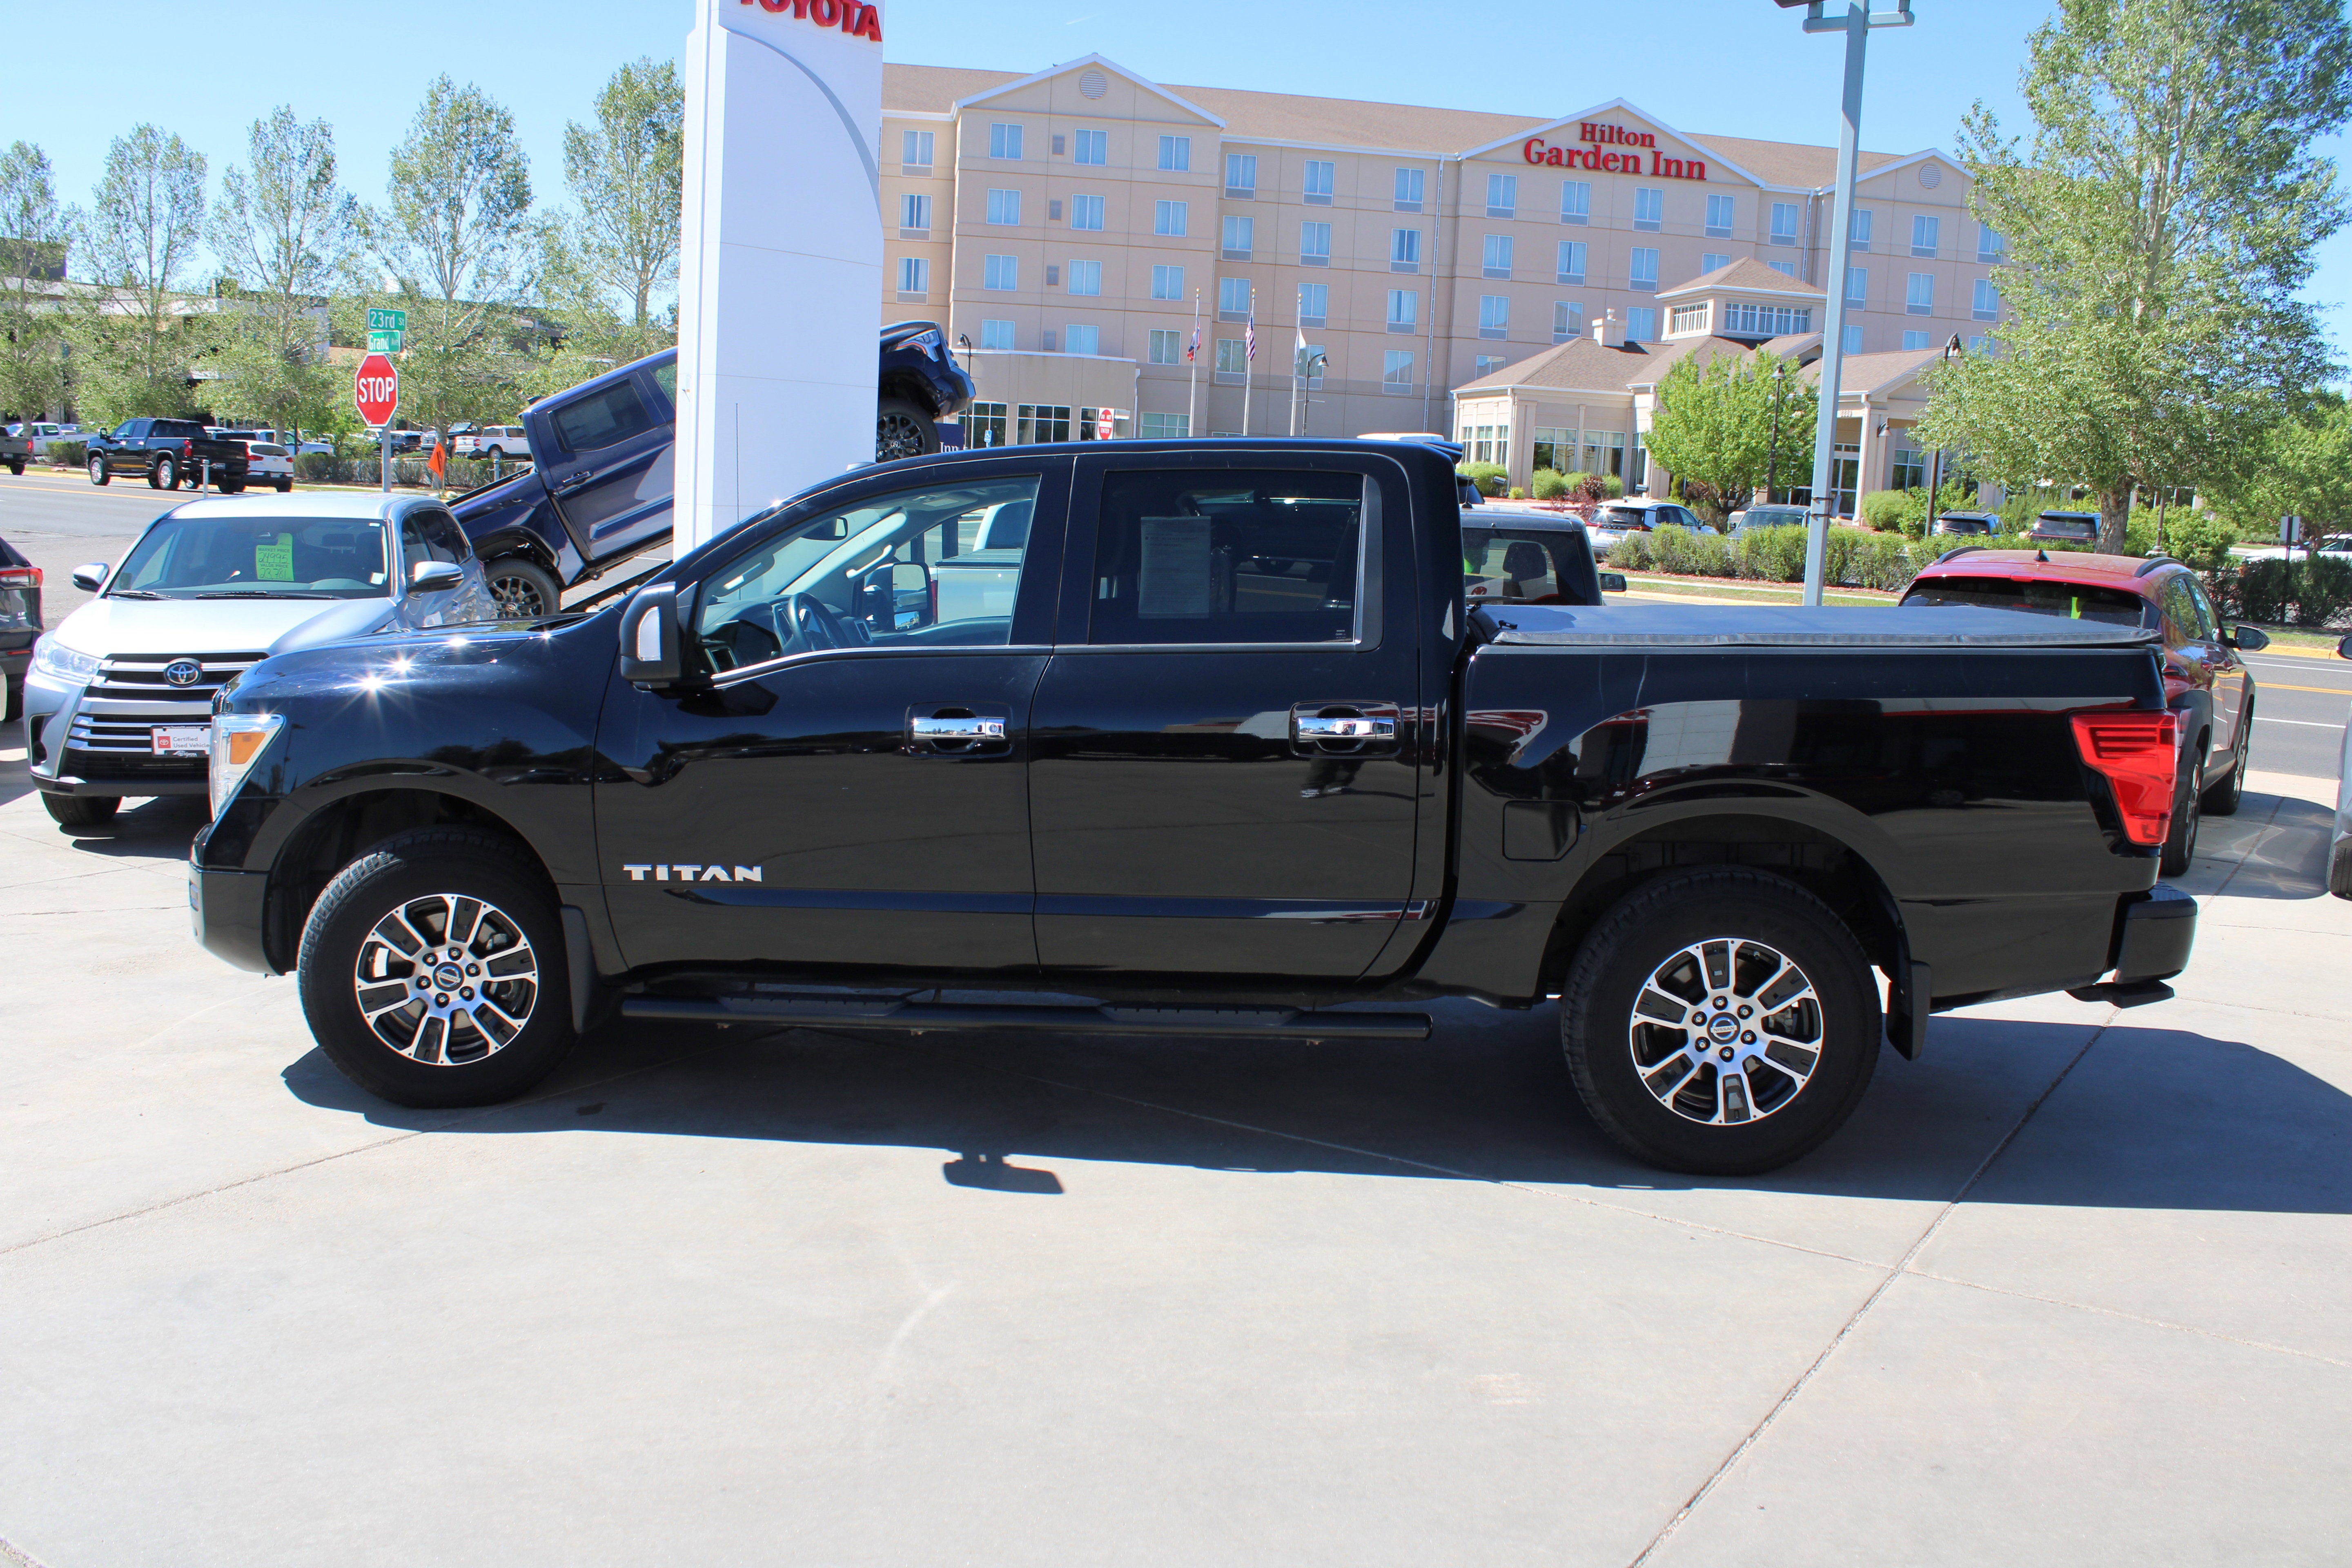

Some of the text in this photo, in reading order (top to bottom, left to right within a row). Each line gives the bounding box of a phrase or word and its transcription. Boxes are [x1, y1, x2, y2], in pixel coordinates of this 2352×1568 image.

[741, 0, 882, 42] YOTA
[1579, 122, 1656, 148] Hilton
[1524, 138, 1707, 180] Garden Inn
[370, 311, 405, 329] 23rd St
[369, 334, 389, 351] Grand
[358, 376, 395, 403] STOP
[940, 442, 960, 453] Inn
[622, 864, 762, 882] TITAN
[439, 972, 459, 982] NISSAN
